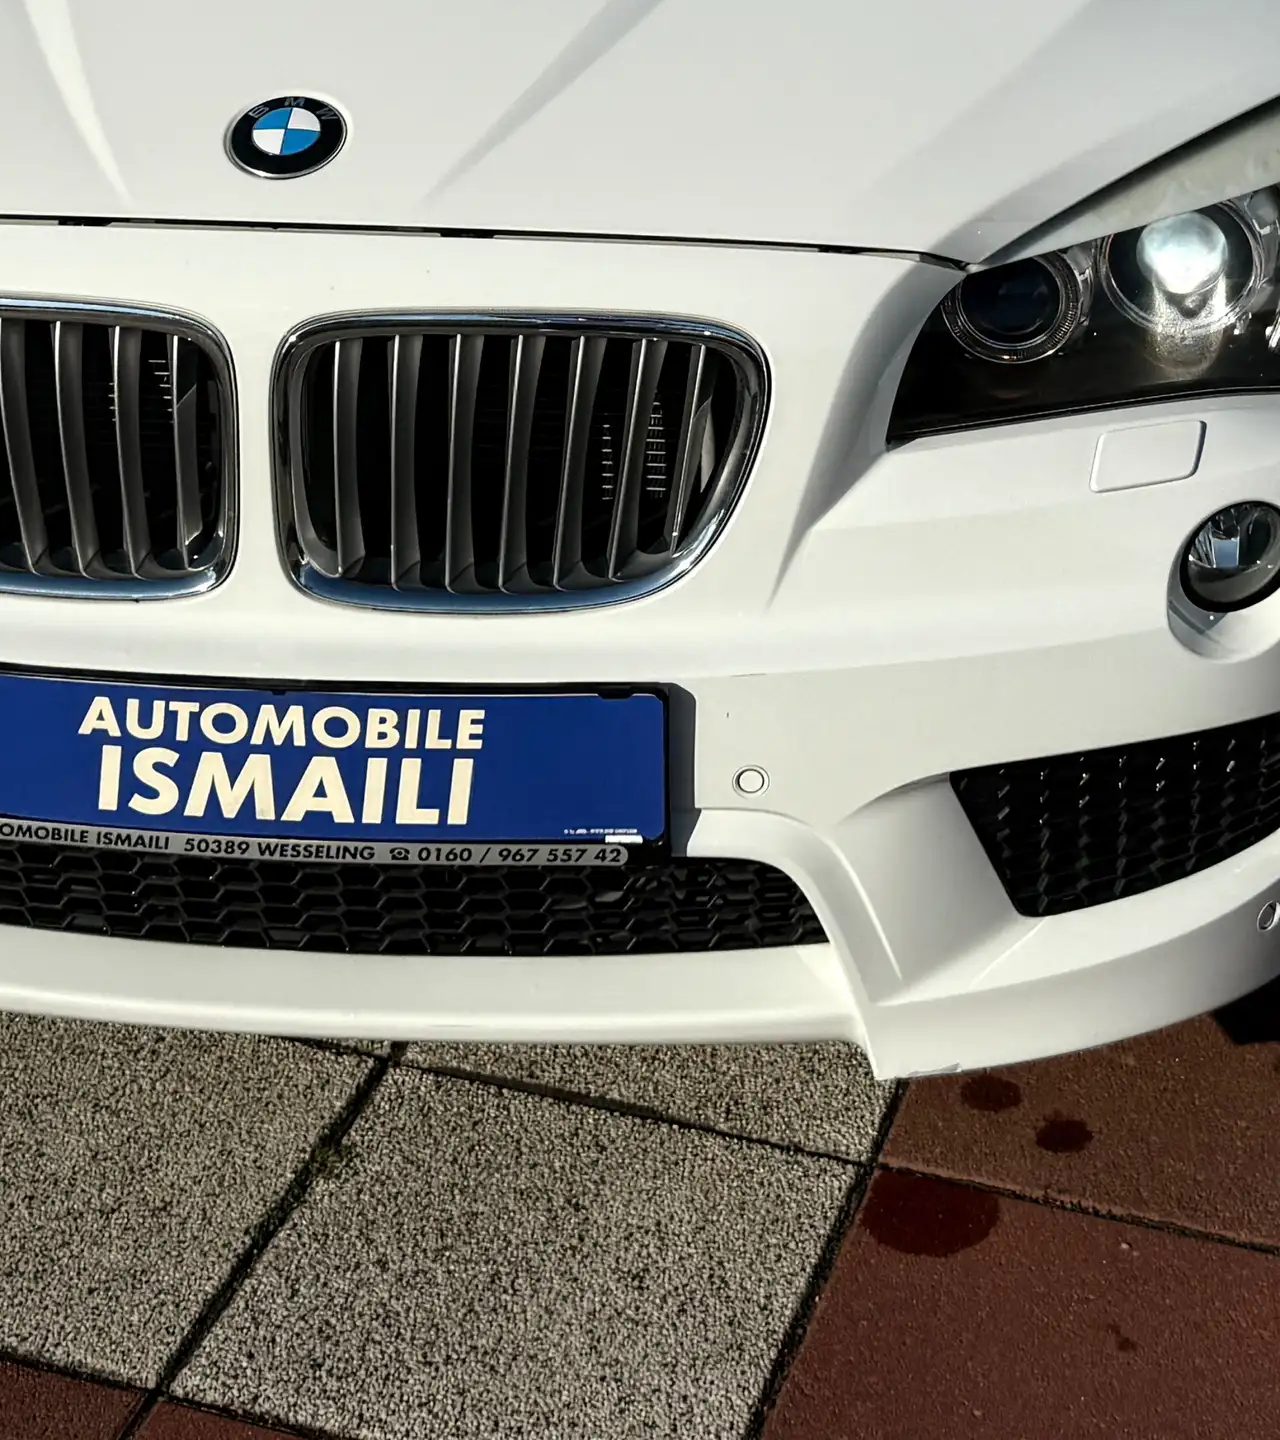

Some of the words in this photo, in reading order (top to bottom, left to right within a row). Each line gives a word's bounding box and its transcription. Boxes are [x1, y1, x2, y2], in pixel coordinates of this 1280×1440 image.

[78, 695, 486, 750] AUTOMOBILE
[97, 744, 474, 825] ISMAILI
[95, 831, 170, 850] ISMAILI
[183, 837, 250, 856] 50389
[257, 842, 376, 861] WESSELING
[417, 847, 472, 863] 0160
[498, 847, 539, 863] 967
[546, 848, 588, 863] 557
[593, 847, 622, 863] 42
